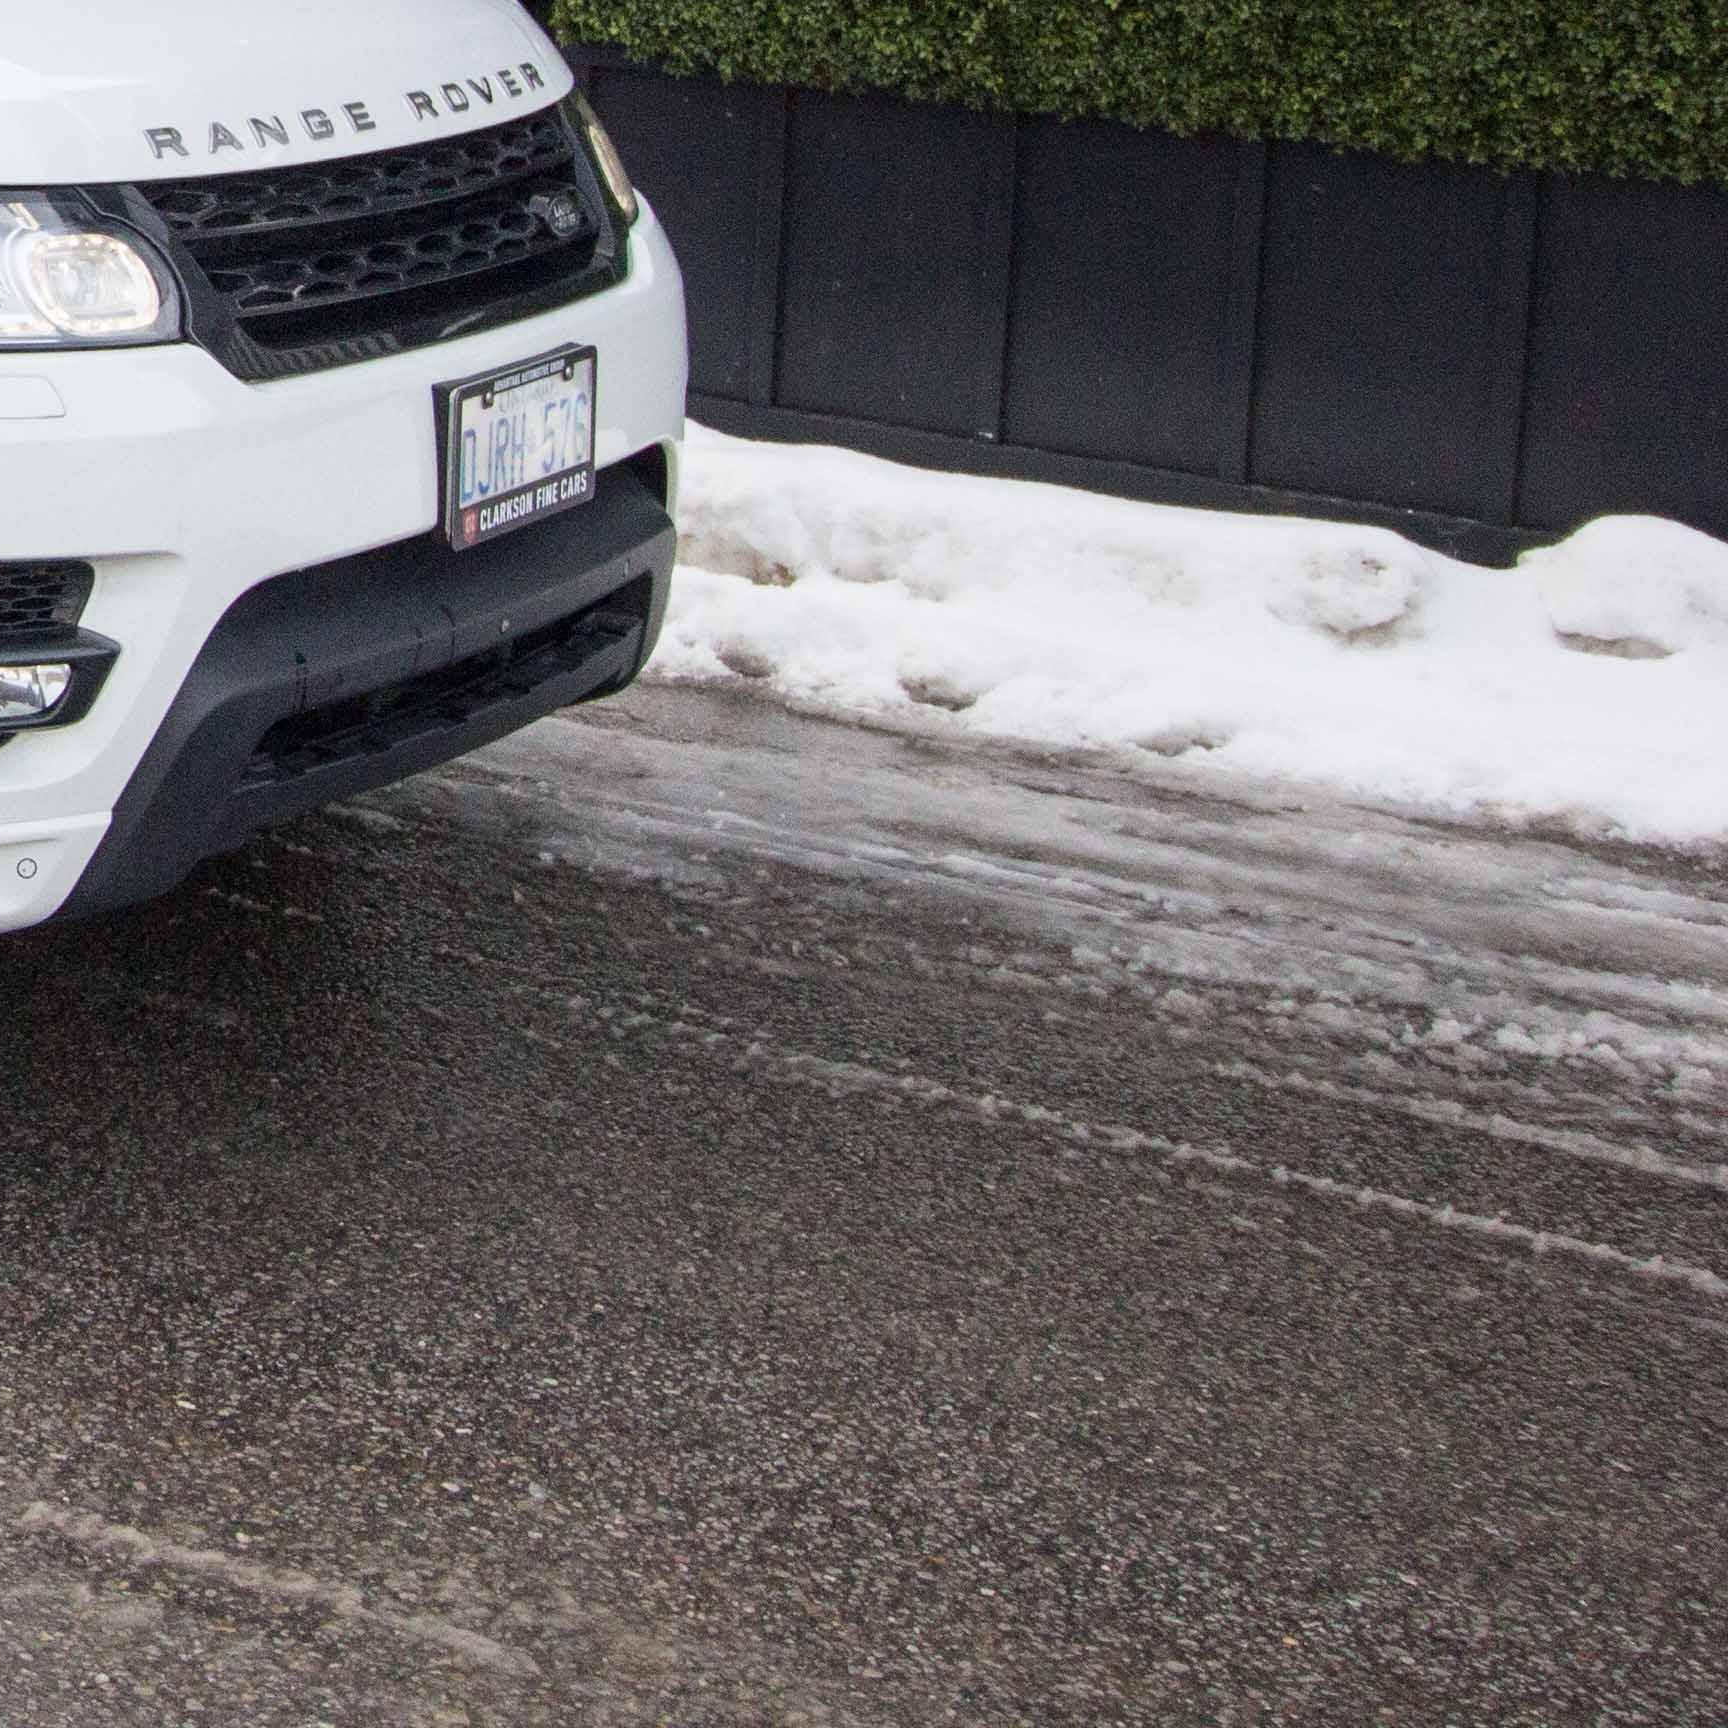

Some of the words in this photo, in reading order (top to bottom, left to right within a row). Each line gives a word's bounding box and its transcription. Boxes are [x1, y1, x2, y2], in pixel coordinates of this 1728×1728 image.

[144, 102, 377, 159] RANGE
[406, 62, 545, 120] ROVER
[480, 492, 533, 531] CLARKSON
[536, 483, 559, 509] FINE
[560, 471, 587, 500] CARS
